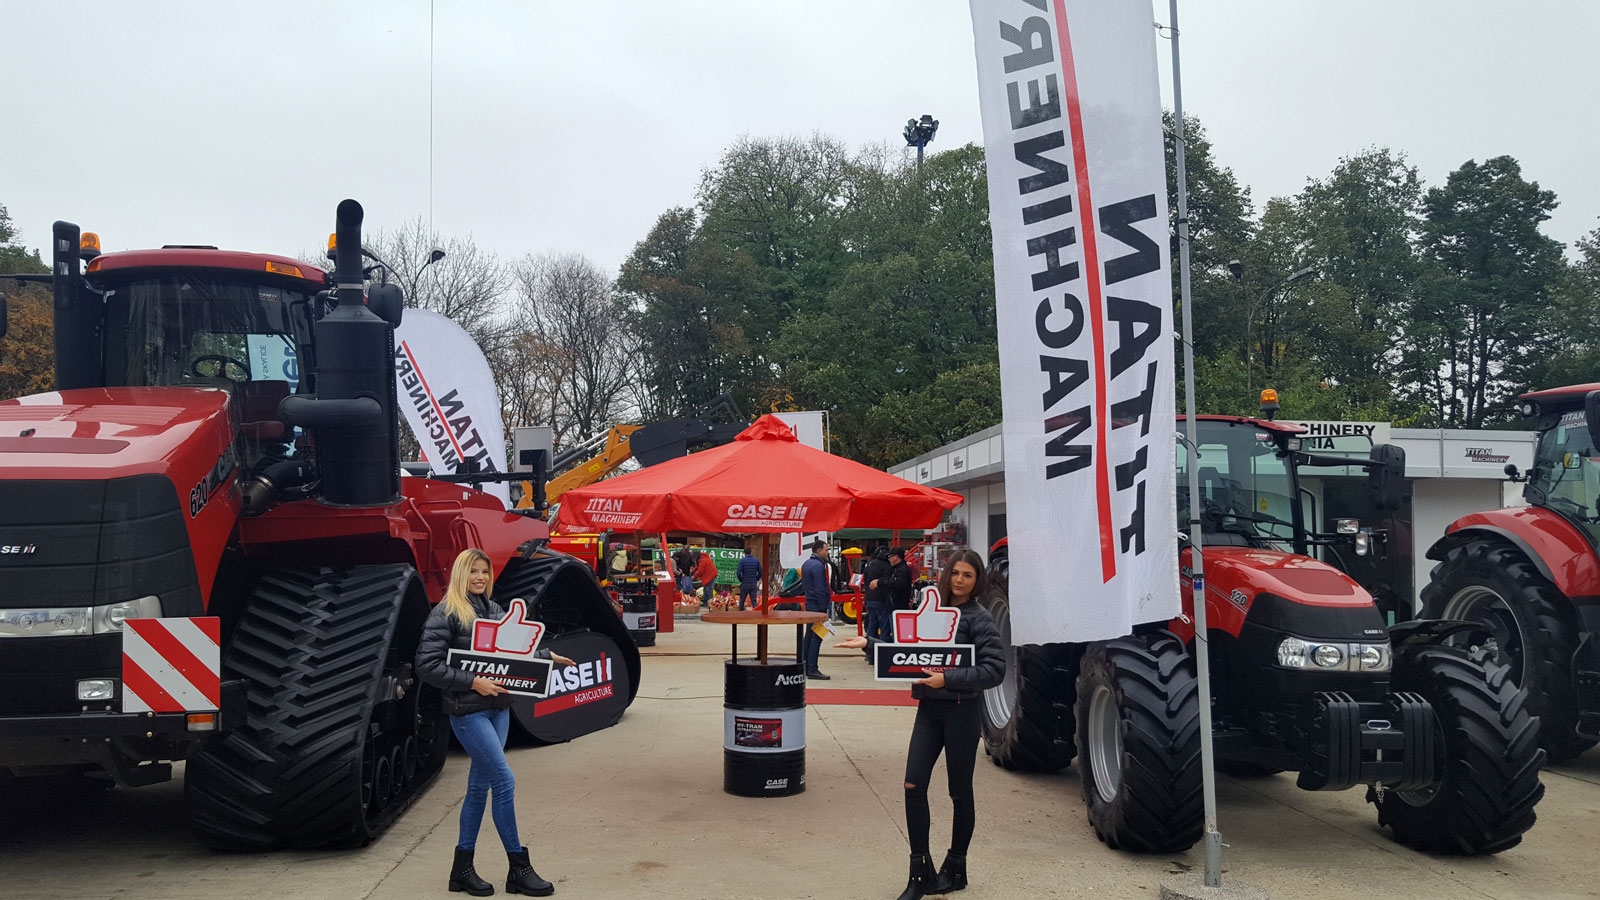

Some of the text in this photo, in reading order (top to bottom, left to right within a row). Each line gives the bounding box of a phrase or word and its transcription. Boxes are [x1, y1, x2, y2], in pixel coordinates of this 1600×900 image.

[1299, 423, 1376, 437] CHINERY
[1465, 448, 1492, 456] TITAN
[189, 476, 208, 518] 620
[586, 497, 624, 512] TITAN
[727, 504, 788, 519] CASE
[591, 513, 641, 525] MACHINERY
[0, 545, 21, 554] SE
[1182, 565, 1194, 578] CAS
[1231, 589, 1248, 606] 120
[892, 652, 944, 666] CASE
[460, 659, 510, 675] TITAN
[549, 661, 594, 696] ASE
[775, 673, 805, 686] AKCEL
[574, 686, 613, 703] AGRICULTURE
[766, 778, 789, 786] CASE
